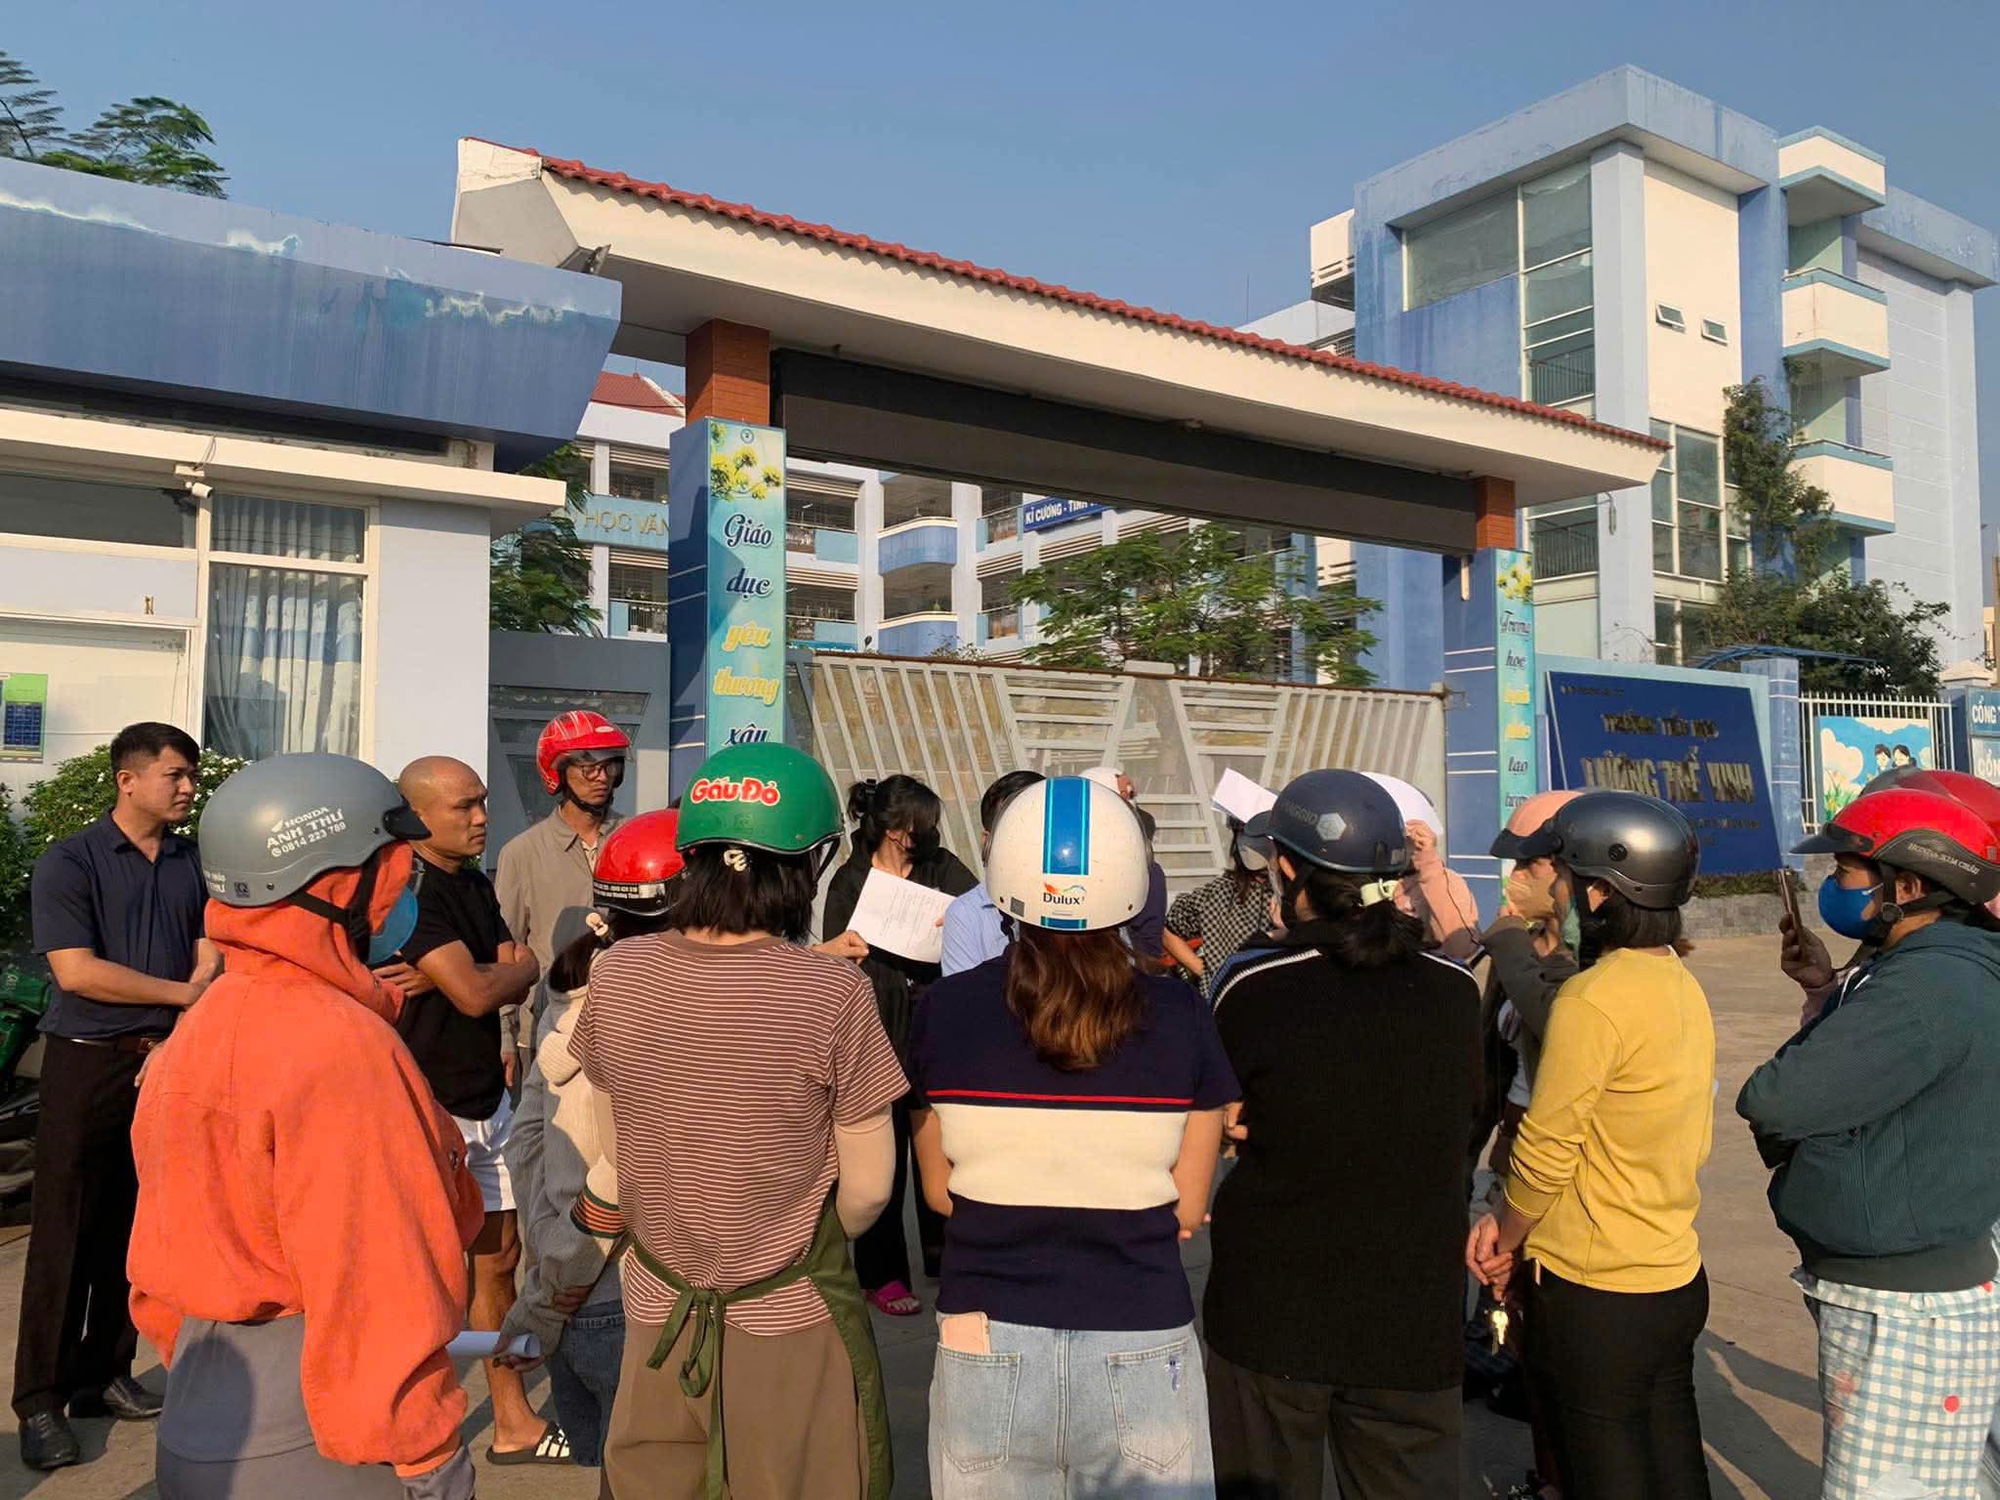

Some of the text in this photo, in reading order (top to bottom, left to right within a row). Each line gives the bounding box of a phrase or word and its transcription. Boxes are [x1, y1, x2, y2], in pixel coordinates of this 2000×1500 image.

[583, 510, 632, 533] HỌC
[724, 513, 773, 548] Giáo
[726, 567, 771, 600] dục
[722, 620, 772, 652] yêu
[1972, 695, 1997, 724] CỔNG
[266, 808, 344, 849] ANH THƯ
[285, 806, 329, 828] HONDA
[282, 821, 346, 853] 0814 223 789
[1043, 891, 1081, 906] Dulux
